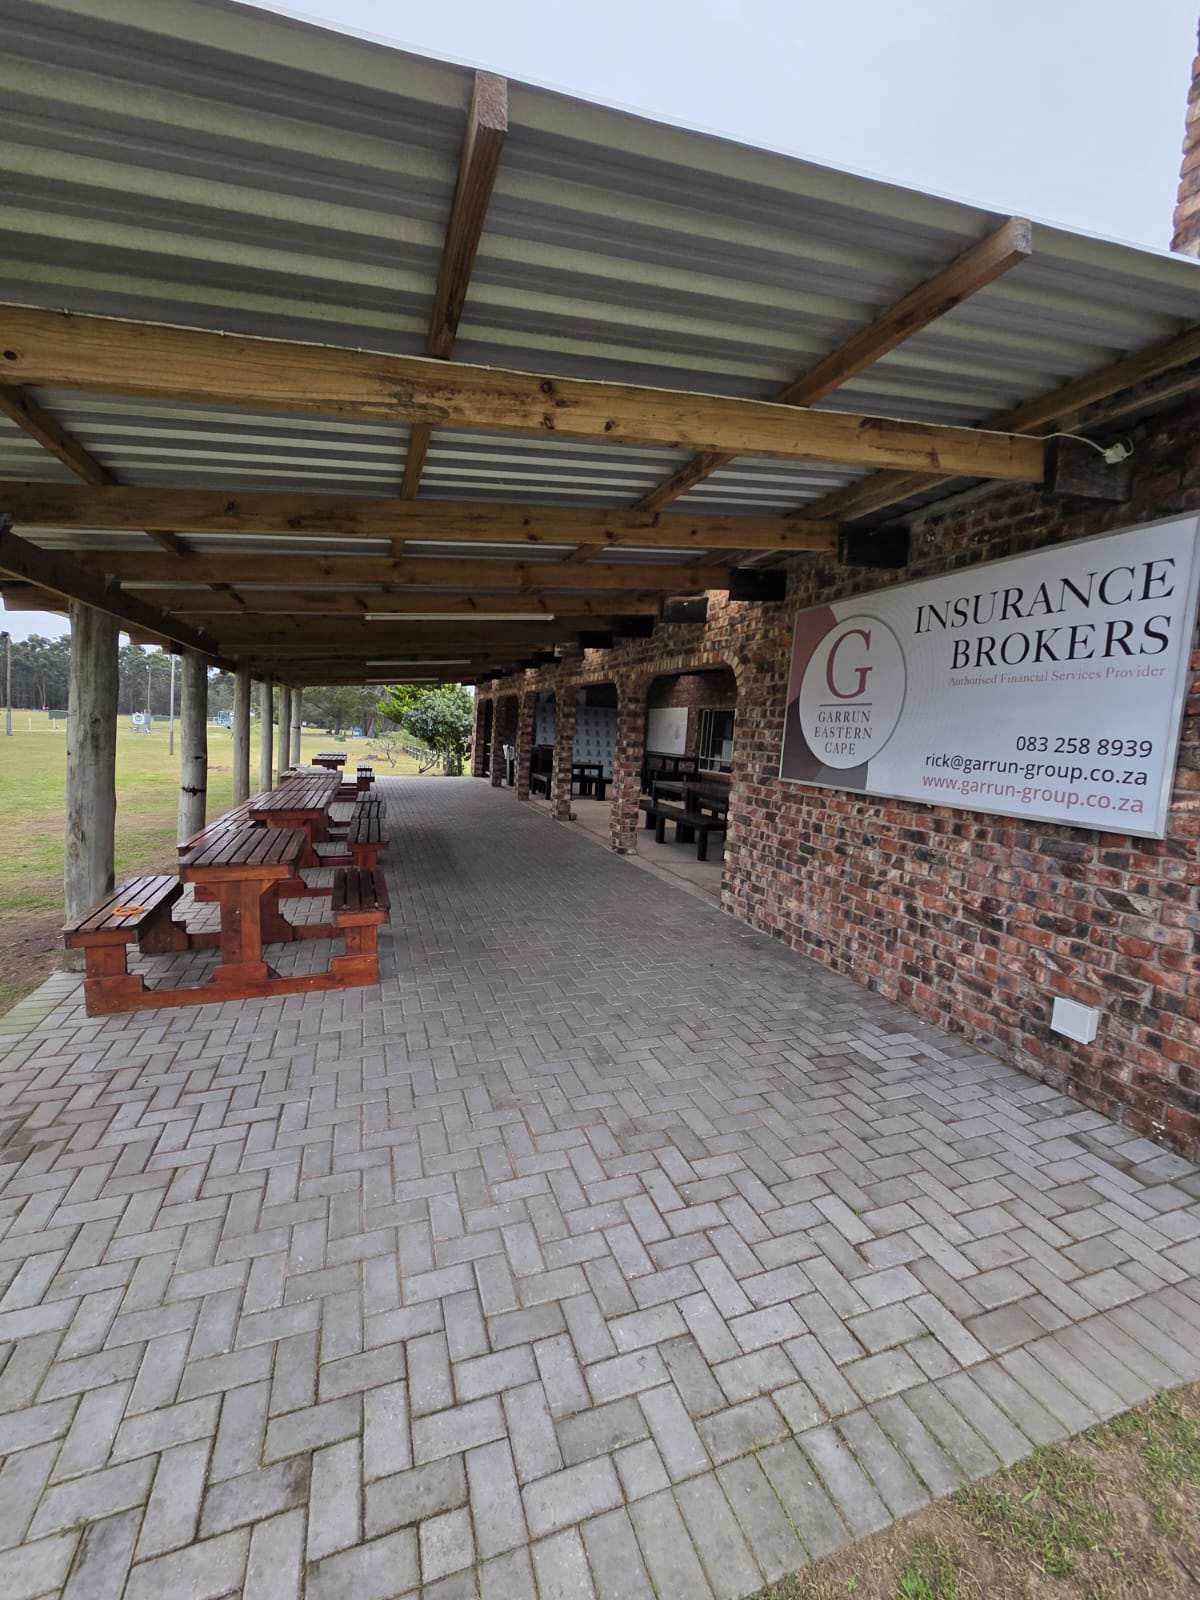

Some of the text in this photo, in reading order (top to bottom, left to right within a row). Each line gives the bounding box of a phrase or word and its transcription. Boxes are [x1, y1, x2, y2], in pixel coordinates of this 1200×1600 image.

[913, 557, 1176, 634] INSURANCE
[949, 614, 1172, 670] BROKERS
[826, 629, 873, 699] G
[950, 664, 1166, 687] Authorised Financial Services Provider
[818, 711, 872, 723] GARRUN
[814, 726, 873, 740] EASTERN
[1016, 735, 1153, 758] 083 258 8939
[825, 741, 856, 755] CAPE
[925, 753, 1149, 786] rick@garrun-group.co.za
[922, 775, 1145, 813] www.garrun-group.co.za
